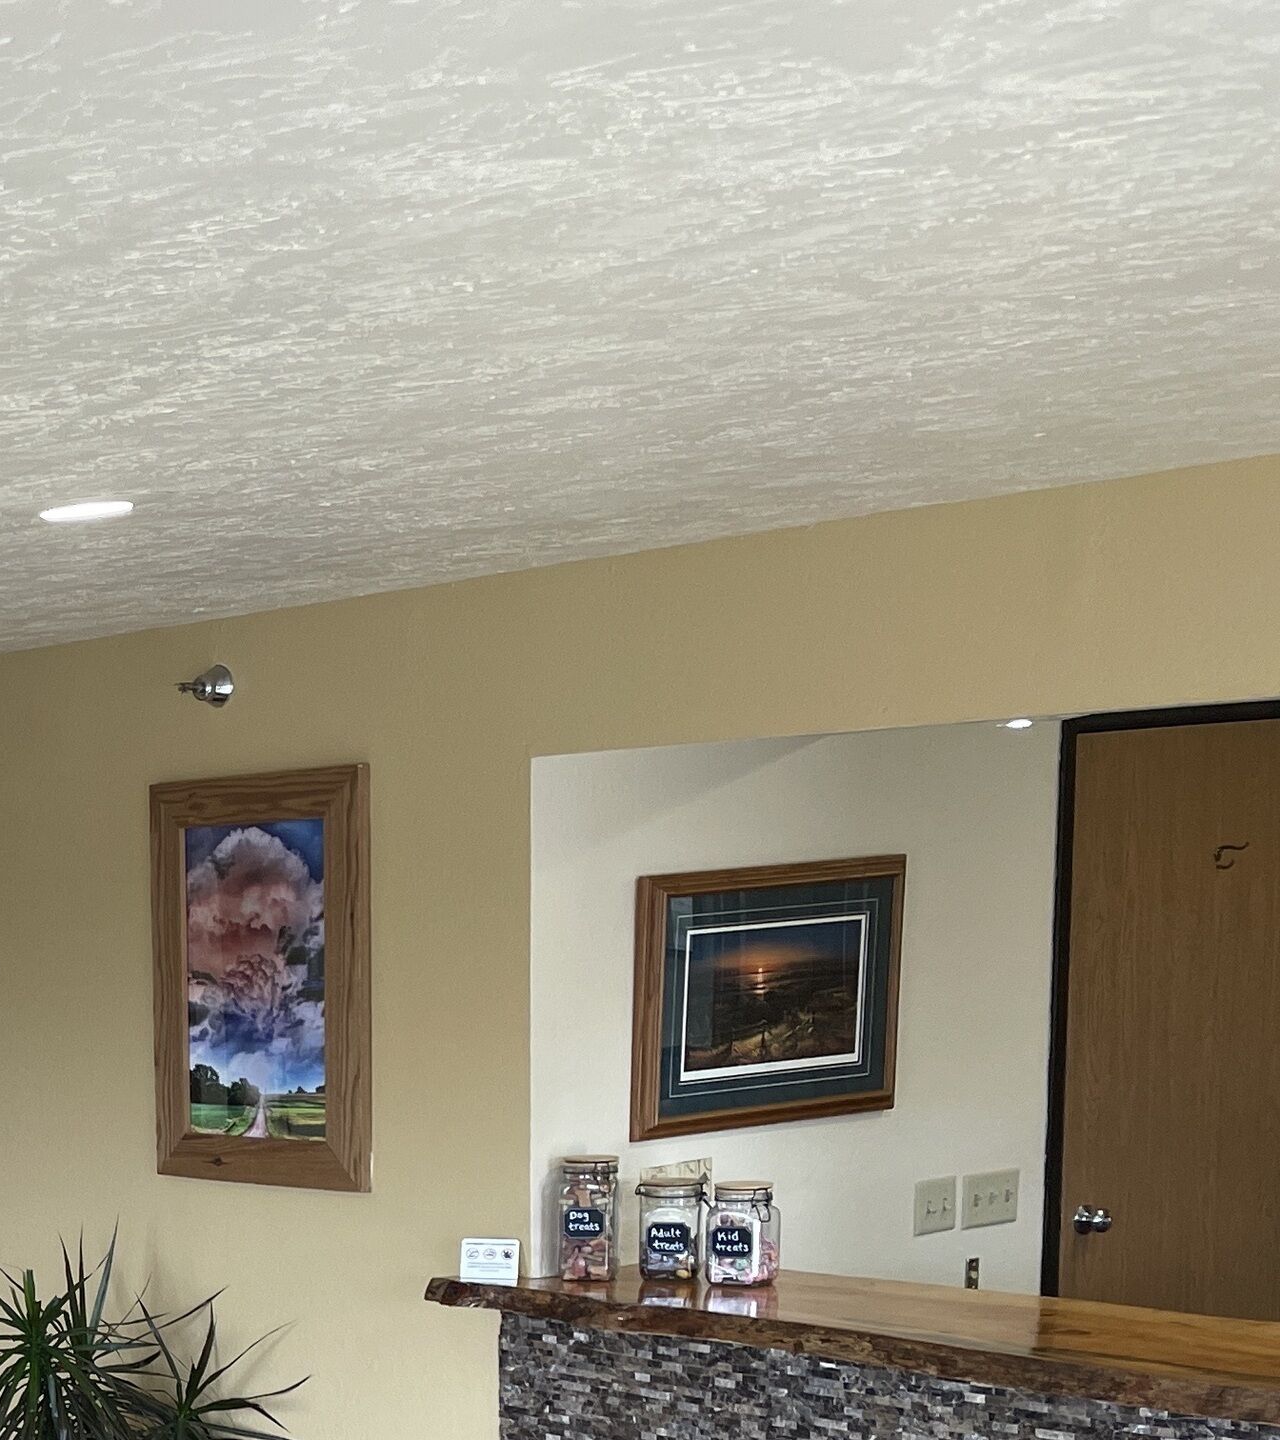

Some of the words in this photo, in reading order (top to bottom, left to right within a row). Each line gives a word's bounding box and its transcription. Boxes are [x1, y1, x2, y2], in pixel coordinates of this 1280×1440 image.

[568, 1211, 589, 1223] Dog
[568, 1222, 600, 1232] treats
[650, 1227, 682, 1239] Adult
[717, 1231, 740, 1242] Kid
[652, 1240, 685, 1251] treats
[715, 1242, 749, 1252] treats
